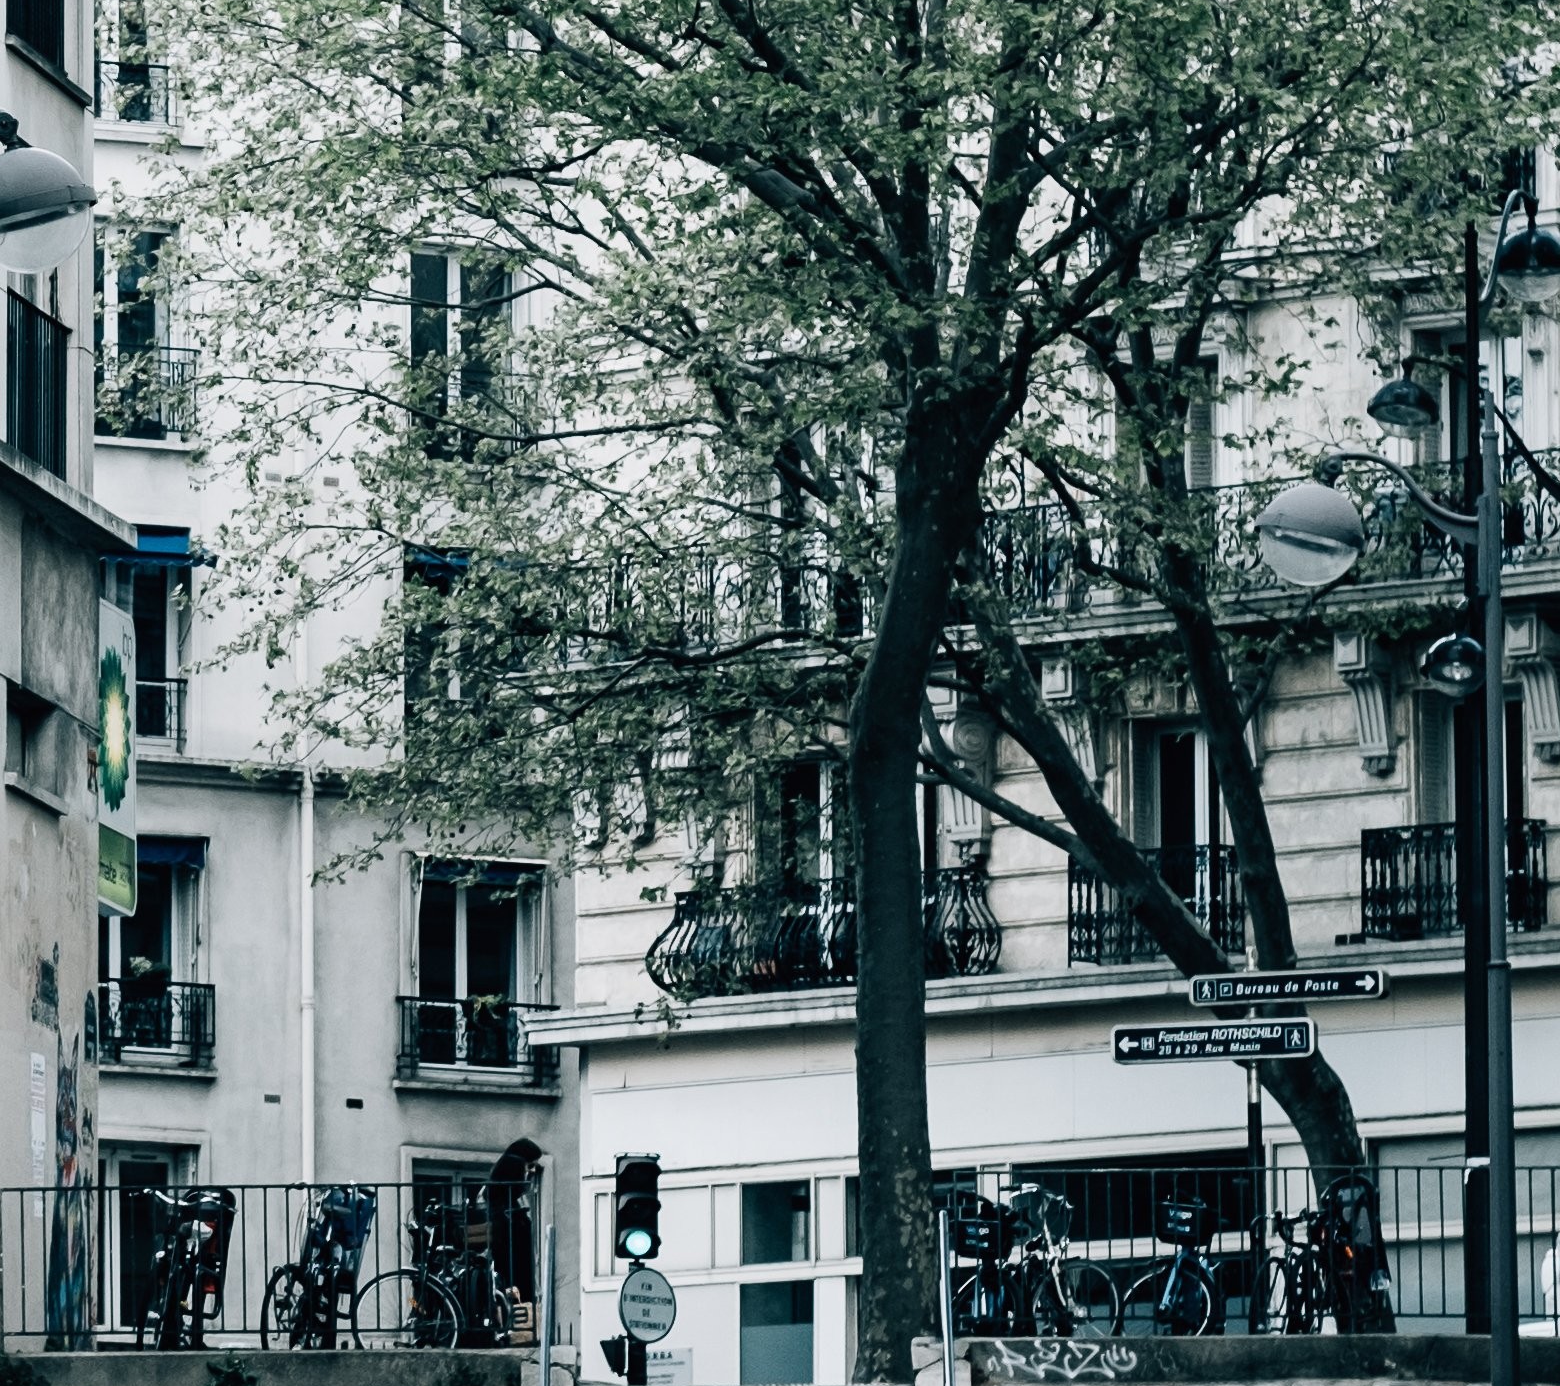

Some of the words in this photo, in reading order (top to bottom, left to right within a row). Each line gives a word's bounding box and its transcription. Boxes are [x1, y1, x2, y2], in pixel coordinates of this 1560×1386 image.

[1236, 982, 1279, 996] Bureau
[1284, 980, 1299, 993] de
[1304, 979, 1339, 992] Poste
[1158, 1030, 1208, 1043] Fondation
[1211, 1026, 1282, 1040] ROTHSCHILD
[1205, 1043, 1224, 1053] Rue
